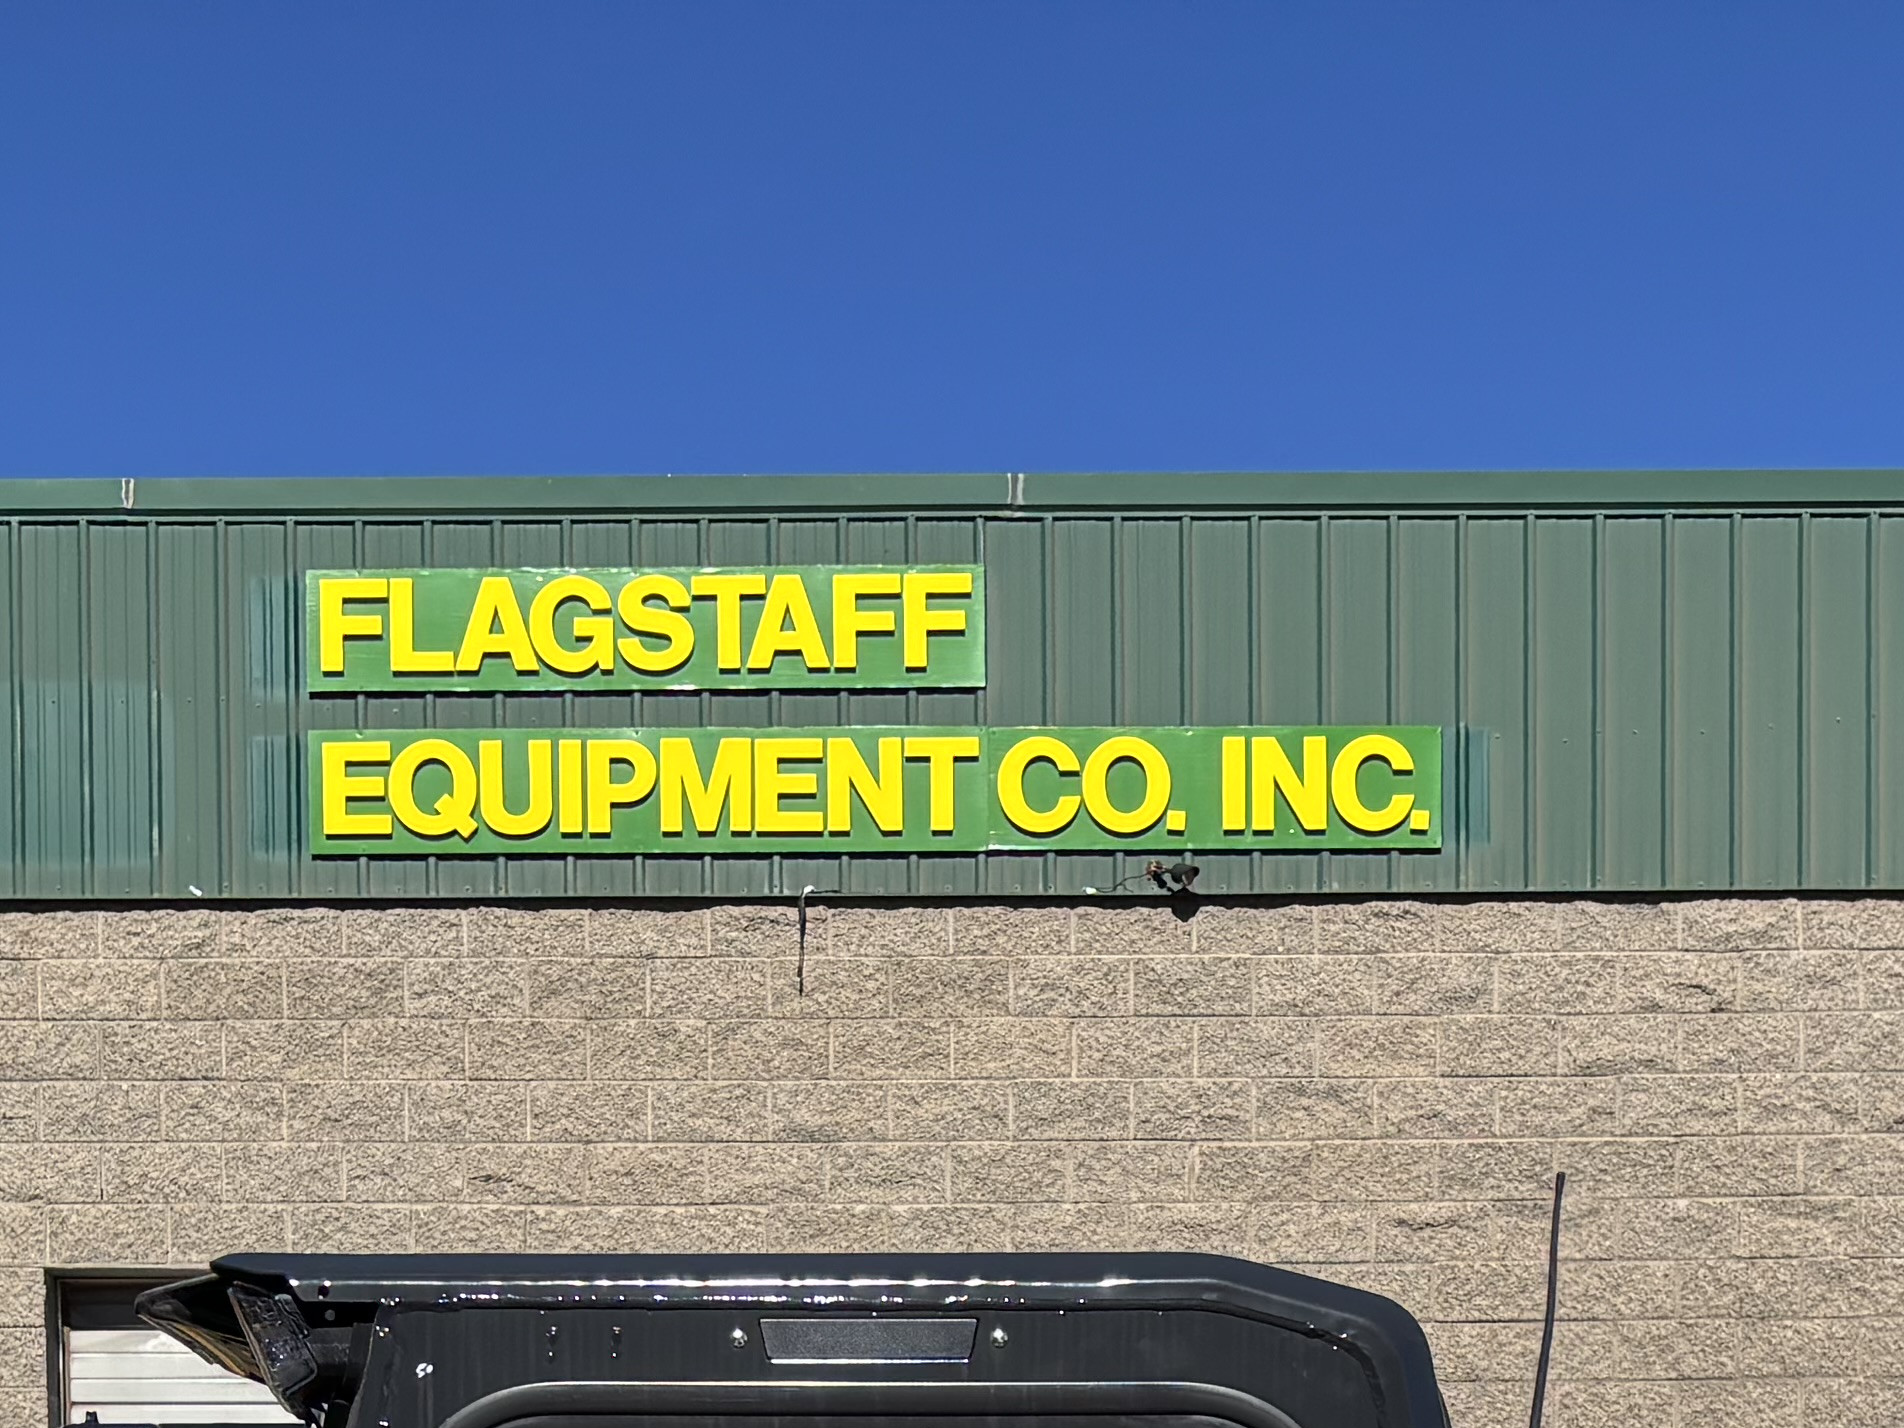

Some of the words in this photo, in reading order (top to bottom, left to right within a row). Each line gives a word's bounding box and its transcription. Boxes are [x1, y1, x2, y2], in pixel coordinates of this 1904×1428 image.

[318, 571, 974, 674] FLAGSTAFF
[320, 735, 981, 839] EQUIPMENT
[996, 734, 1187, 834] CO.
[1220, 733, 1431, 833] INC.
